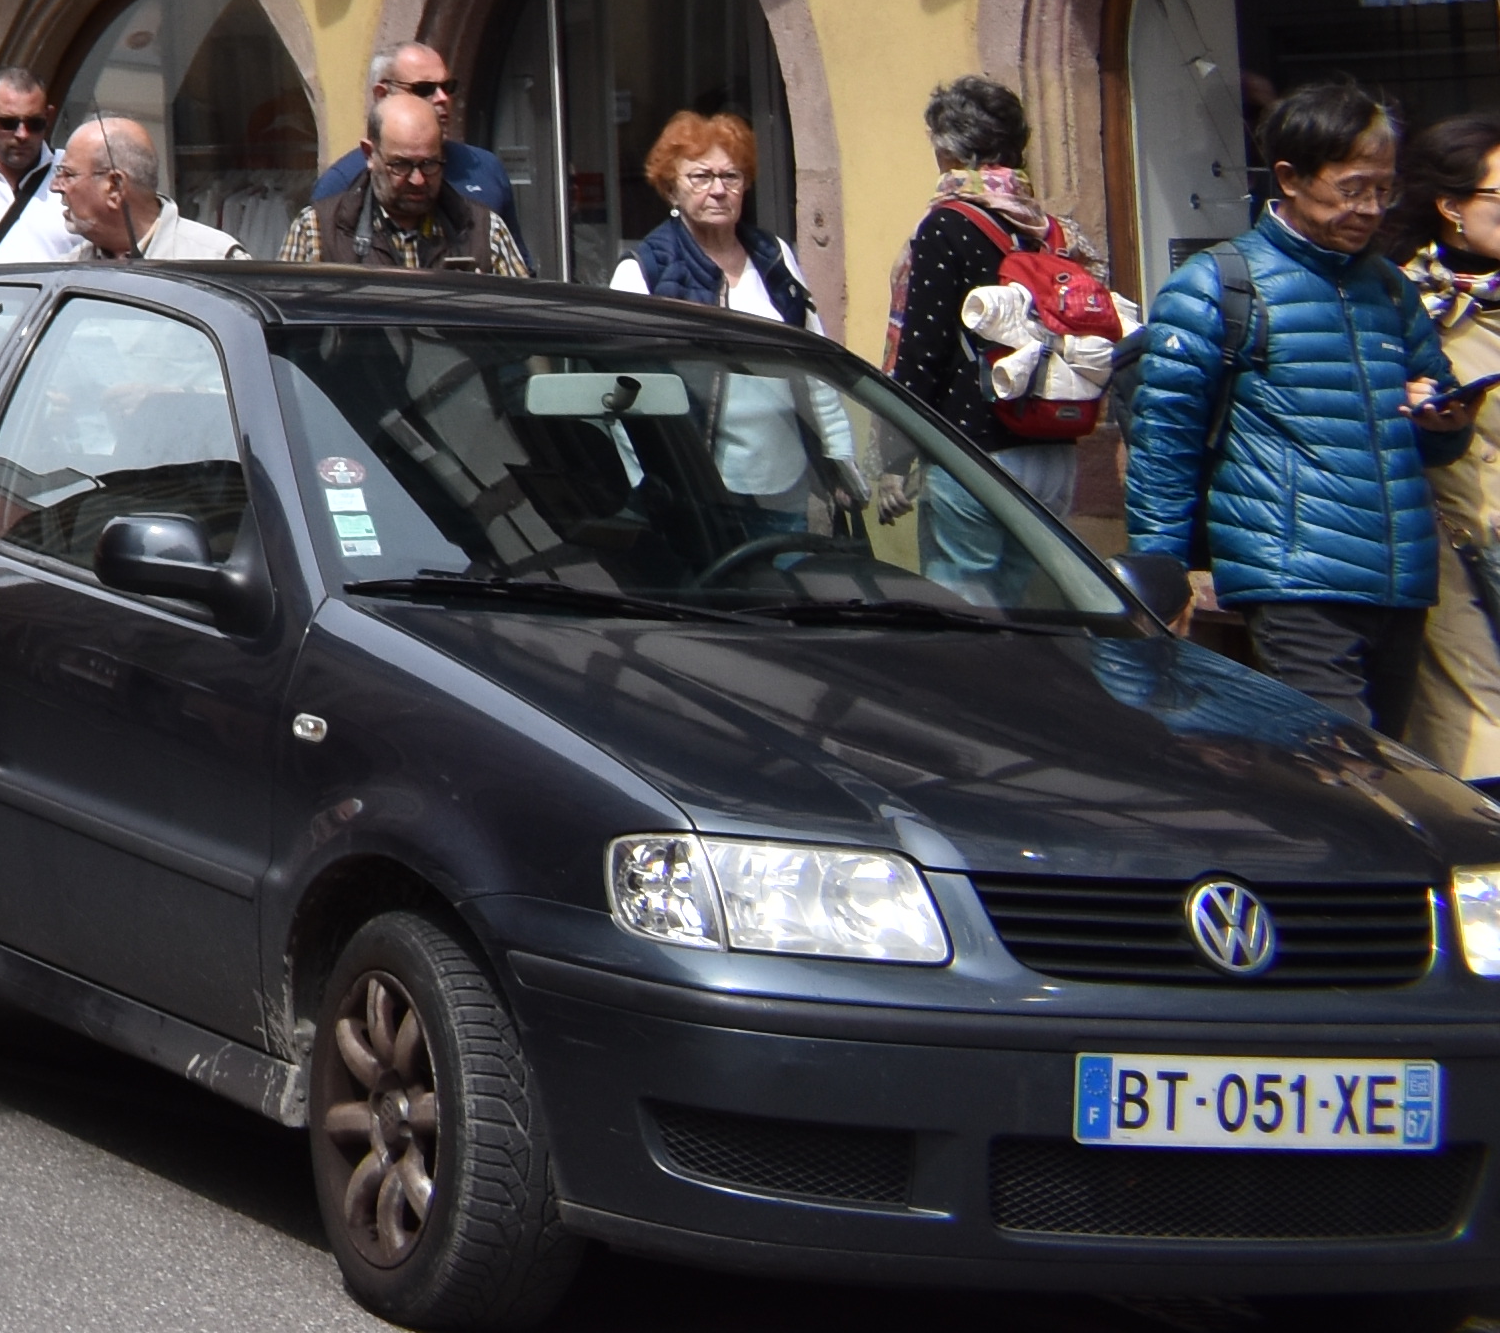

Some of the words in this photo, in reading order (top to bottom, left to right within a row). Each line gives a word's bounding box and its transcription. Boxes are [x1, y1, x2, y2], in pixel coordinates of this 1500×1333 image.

[1088, 1107, 1100, 1125] F
[1116, 1069, 1397, 1135] BT-051-XE
[1406, 1110, 1430, 1138] 67
